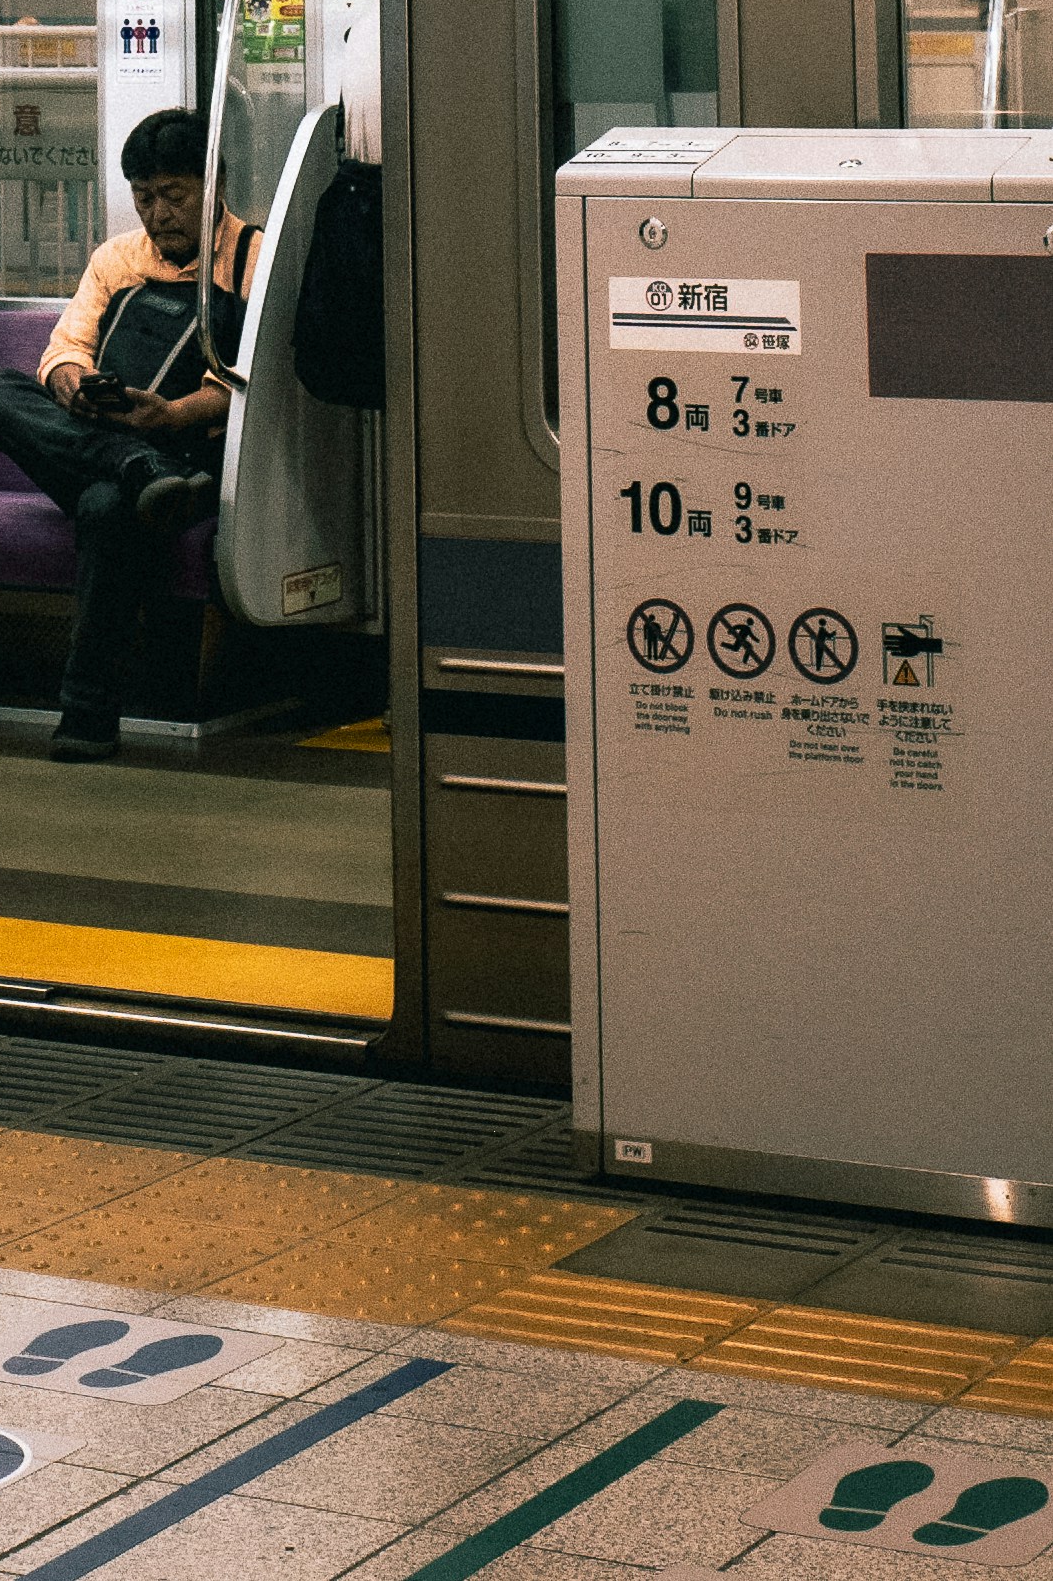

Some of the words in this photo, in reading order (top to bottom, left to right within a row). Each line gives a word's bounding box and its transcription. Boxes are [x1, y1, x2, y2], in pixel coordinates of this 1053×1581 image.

[651, 292, 667, 306] 01
[677, 283, 728, 312] 新宿
[762, 334, 790, 350] 笹塚
[636, 701, 647, 710] Do
[714, 706, 728, 717] Do
[731, 709, 747, 719] not
[750, 710, 773, 720] rush
[807, 724, 846, 738] ください
[789, 739, 803, 749] Do
